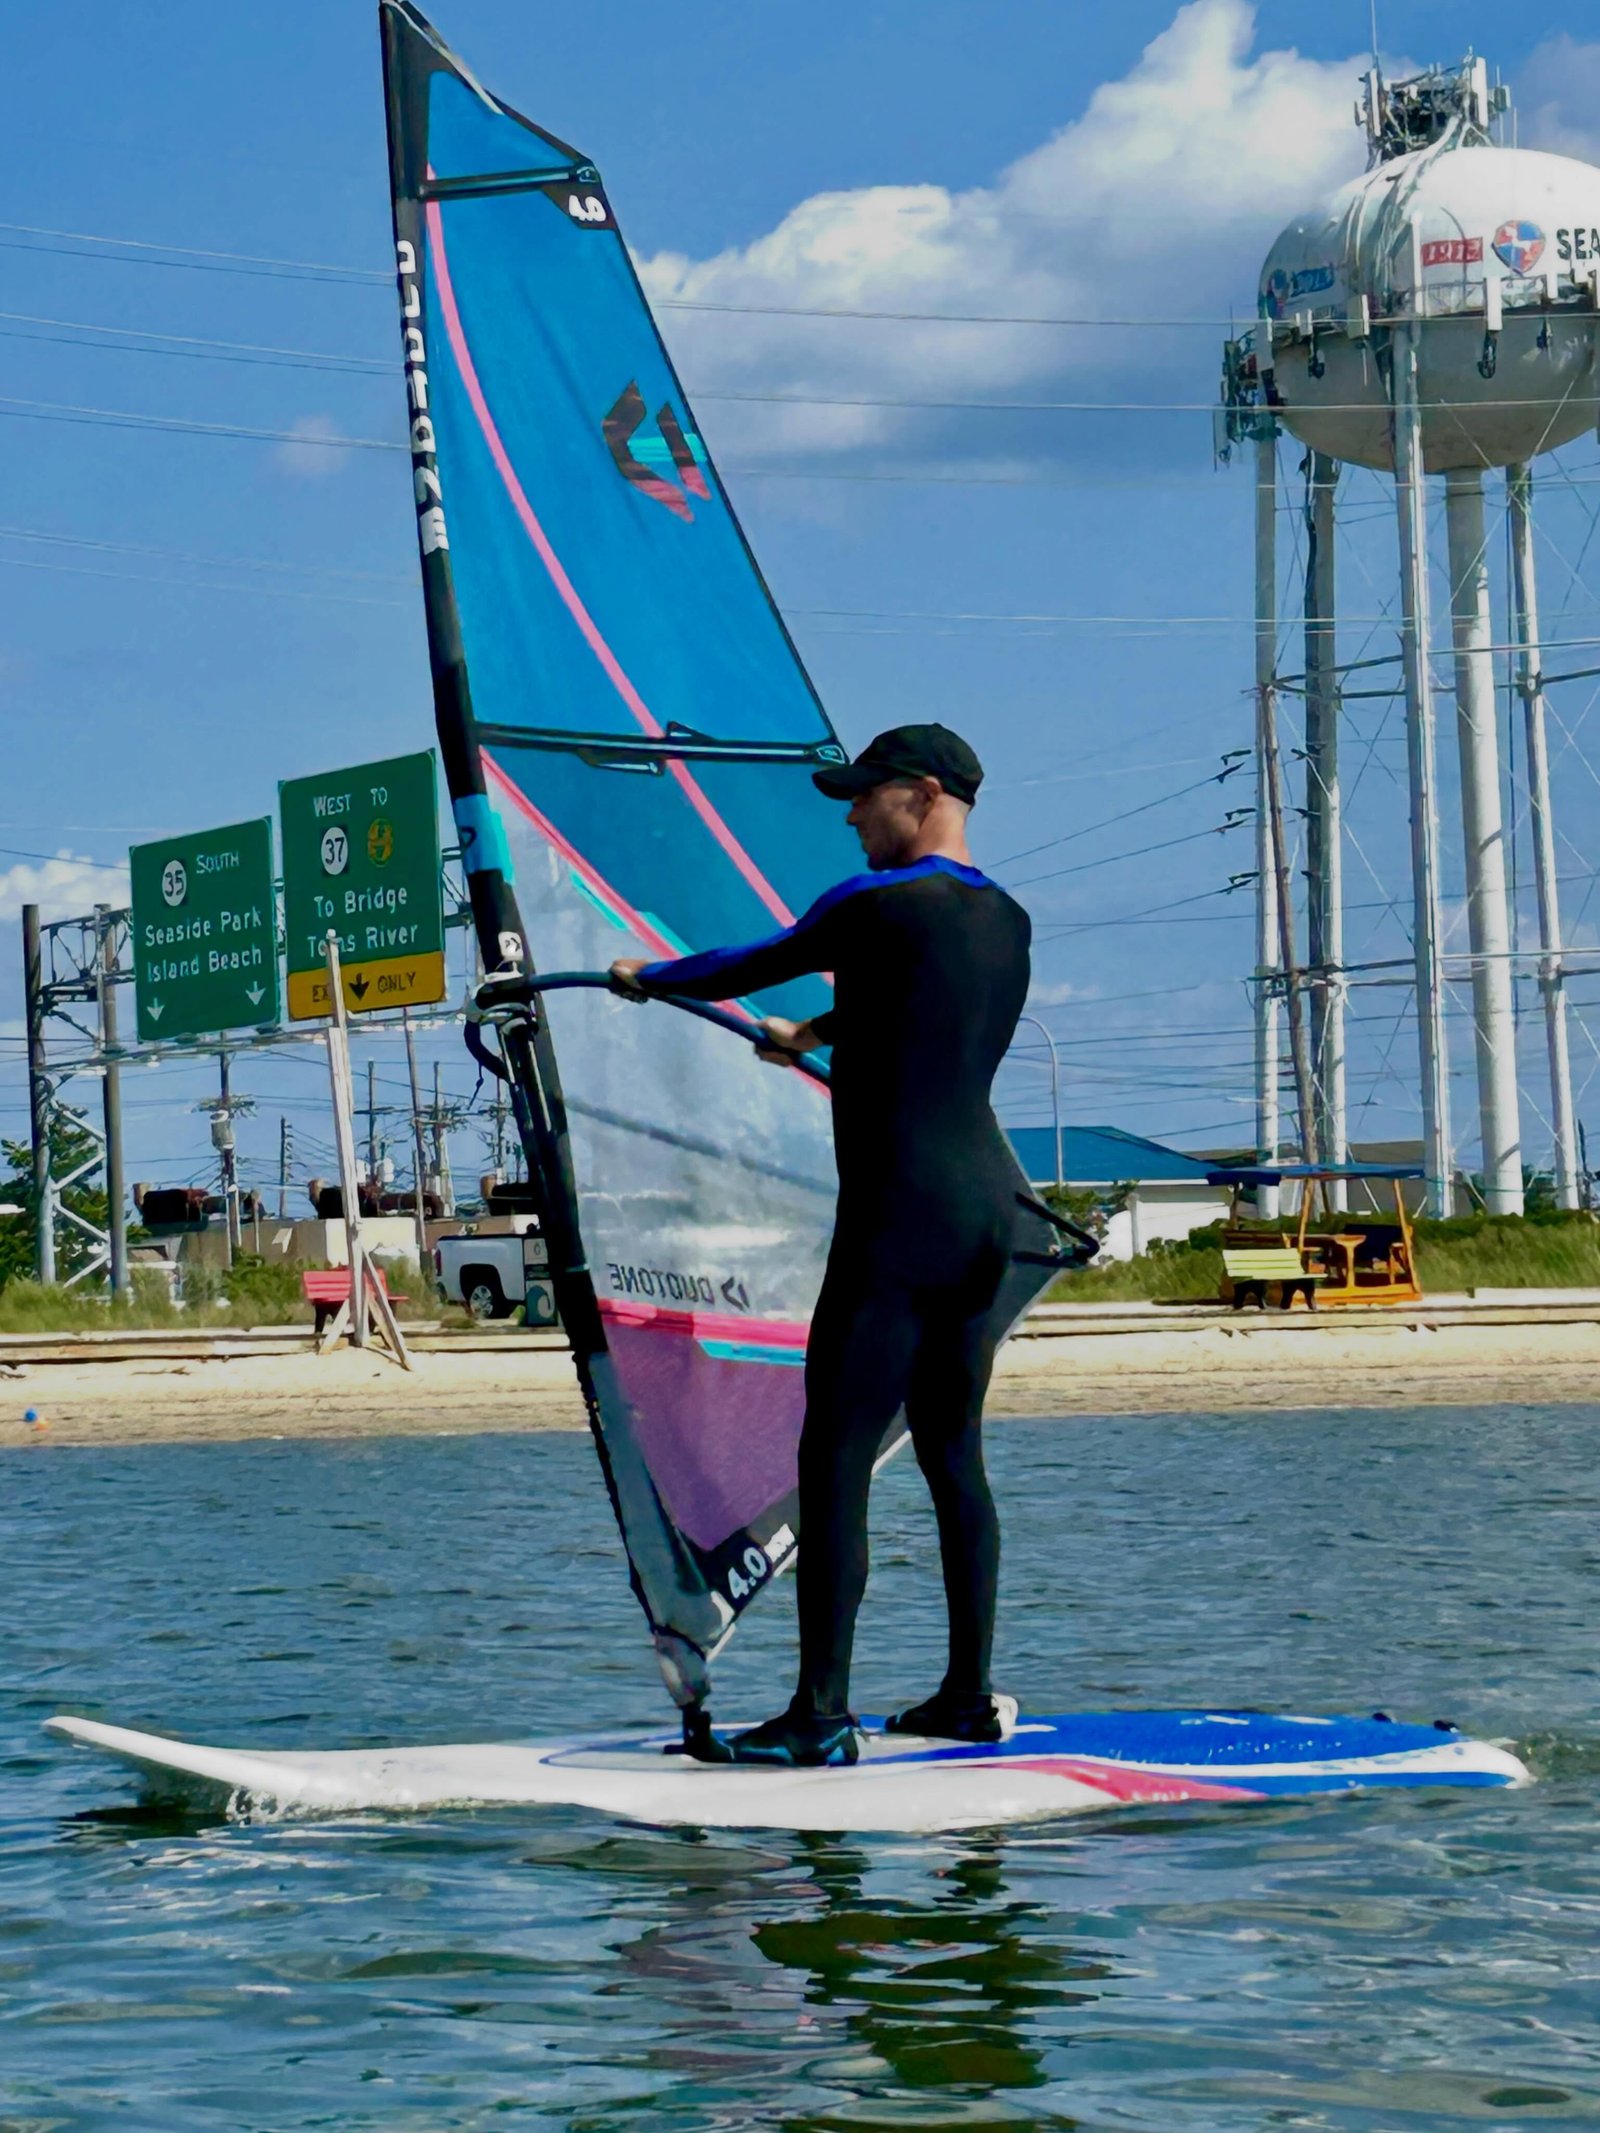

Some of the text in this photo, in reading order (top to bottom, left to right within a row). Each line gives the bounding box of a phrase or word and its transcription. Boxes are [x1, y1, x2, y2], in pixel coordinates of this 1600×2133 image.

[313, 786, 388, 817] WEST TO
[325, 836, 345, 866] 37
[164, 851, 240, 898] 35 SOUTH
[313, 886, 408, 918] To Bridge
[145, 905, 262, 947] Seaside Park
[365, 924, 418, 950] River
[148, 944, 262, 984] Island Beach
[377, 971, 417, 994] ONLY
[727, 1546, 768, 1599] 4.0
